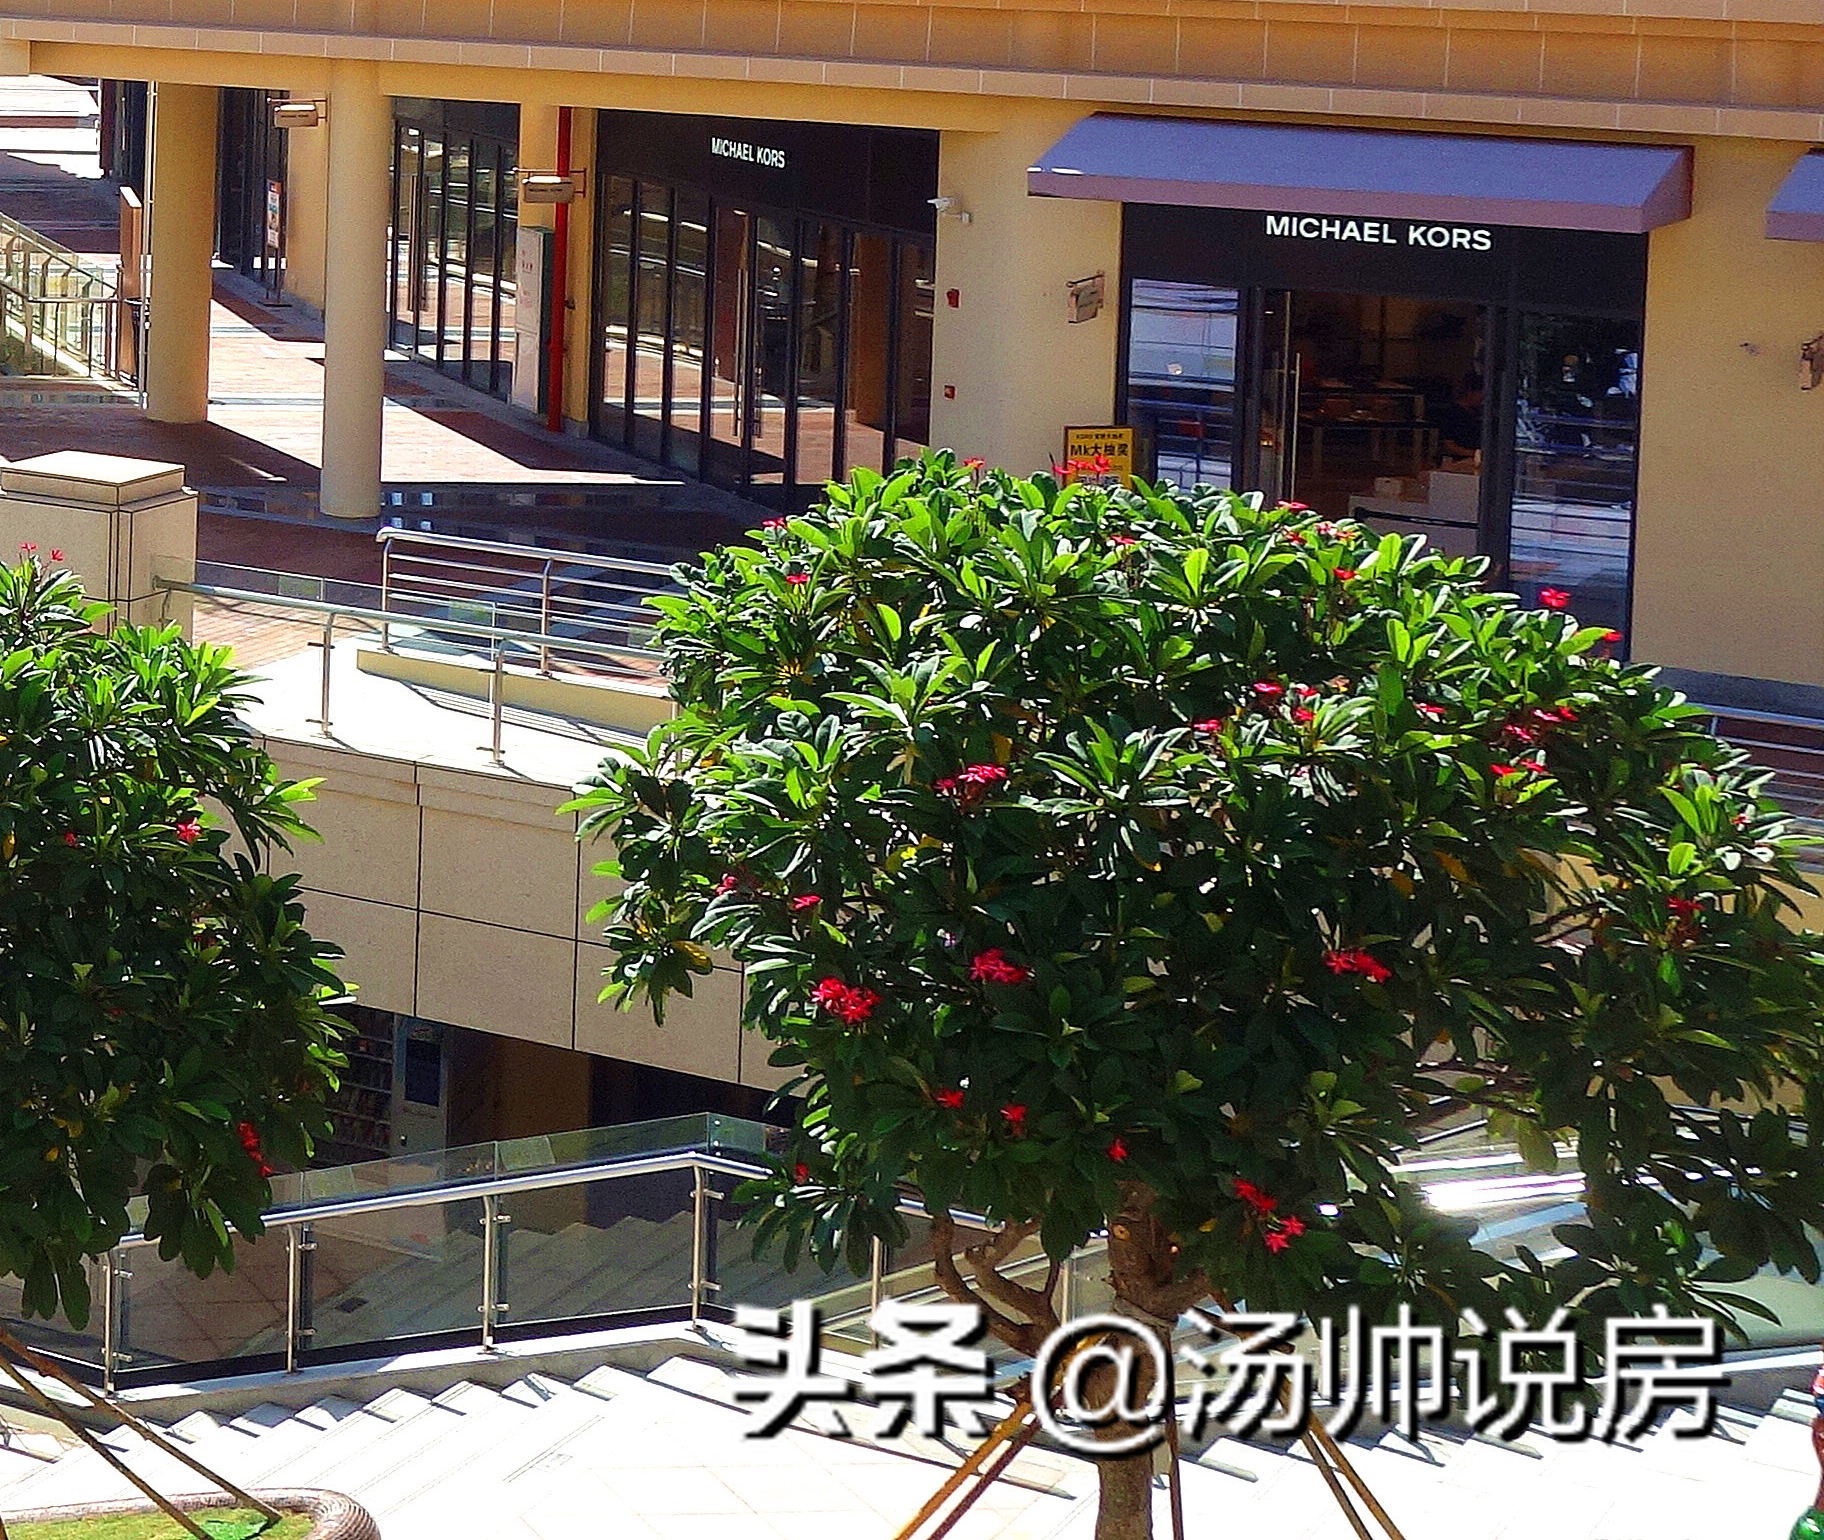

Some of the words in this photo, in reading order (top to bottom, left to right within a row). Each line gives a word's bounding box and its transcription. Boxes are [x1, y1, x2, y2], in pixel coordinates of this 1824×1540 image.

[711, 137, 755, 162] MICHAEL
[756, 145, 785, 169] KORS
[1265, 215, 1398, 244] MICHAEL
[1407, 225, 1493, 251] KORS
